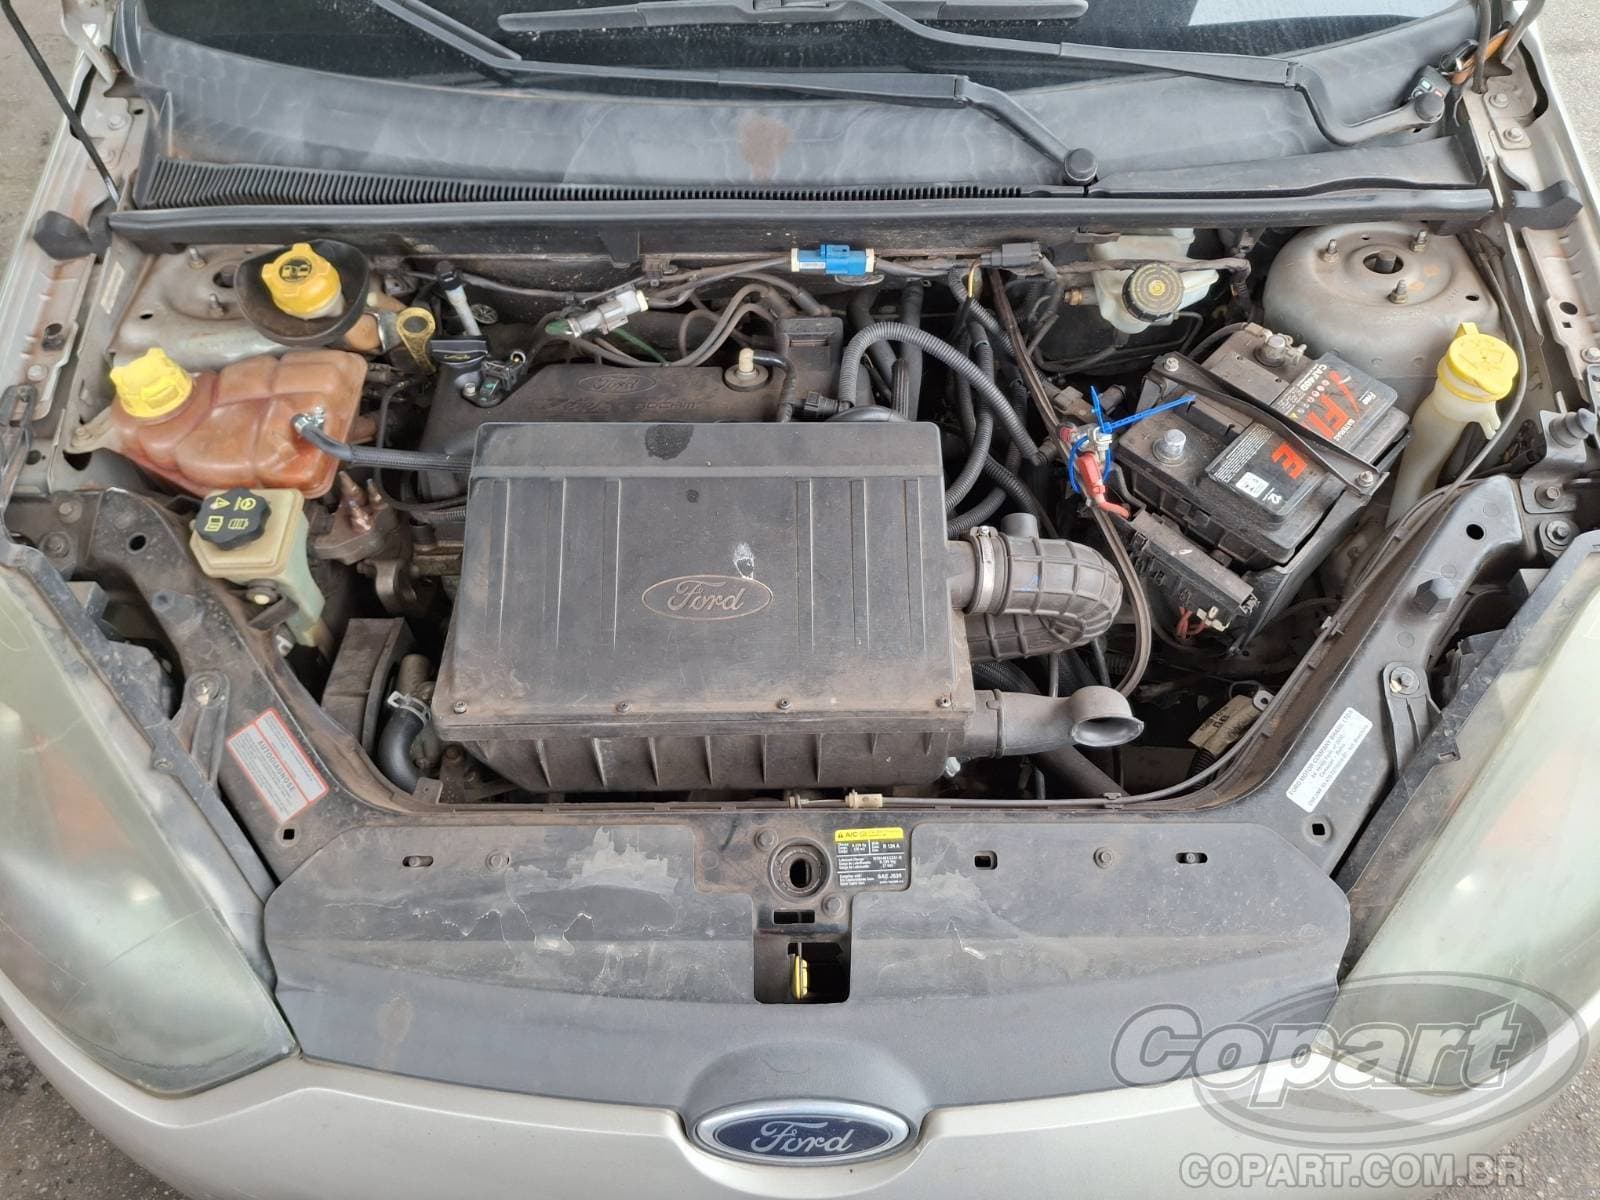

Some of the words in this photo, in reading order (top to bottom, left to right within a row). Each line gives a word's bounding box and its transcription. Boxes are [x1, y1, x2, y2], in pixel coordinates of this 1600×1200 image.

[592, 376, 640, 391] Ford
[667, 580, 748, 611] Ford
[751, 1120, 854, 1154] Ford
